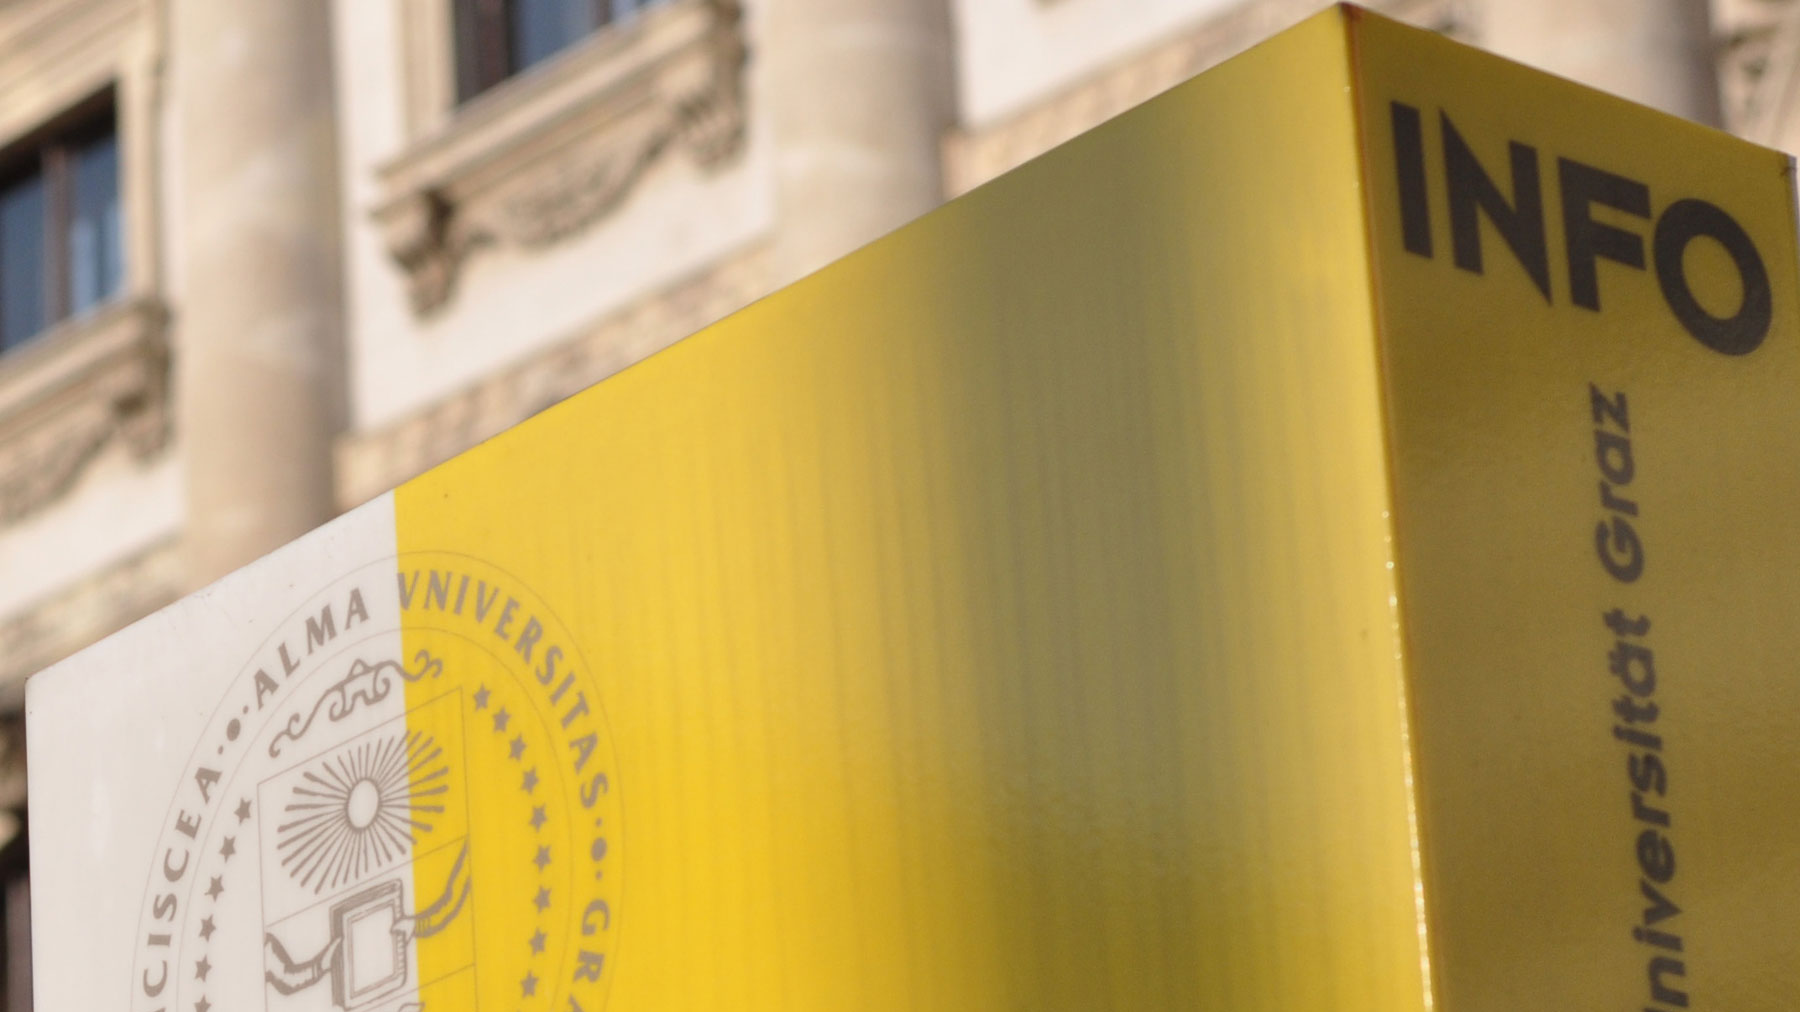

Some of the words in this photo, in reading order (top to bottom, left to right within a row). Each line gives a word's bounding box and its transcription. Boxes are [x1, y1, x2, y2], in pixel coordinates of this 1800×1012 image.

[1390, 101, 1772, 356] INFO
[1589, 381, 1643, 584] Graz
[251, 586, 370, 711] ALMA
[397, 570, 609, 811] VNIVERSITAS
